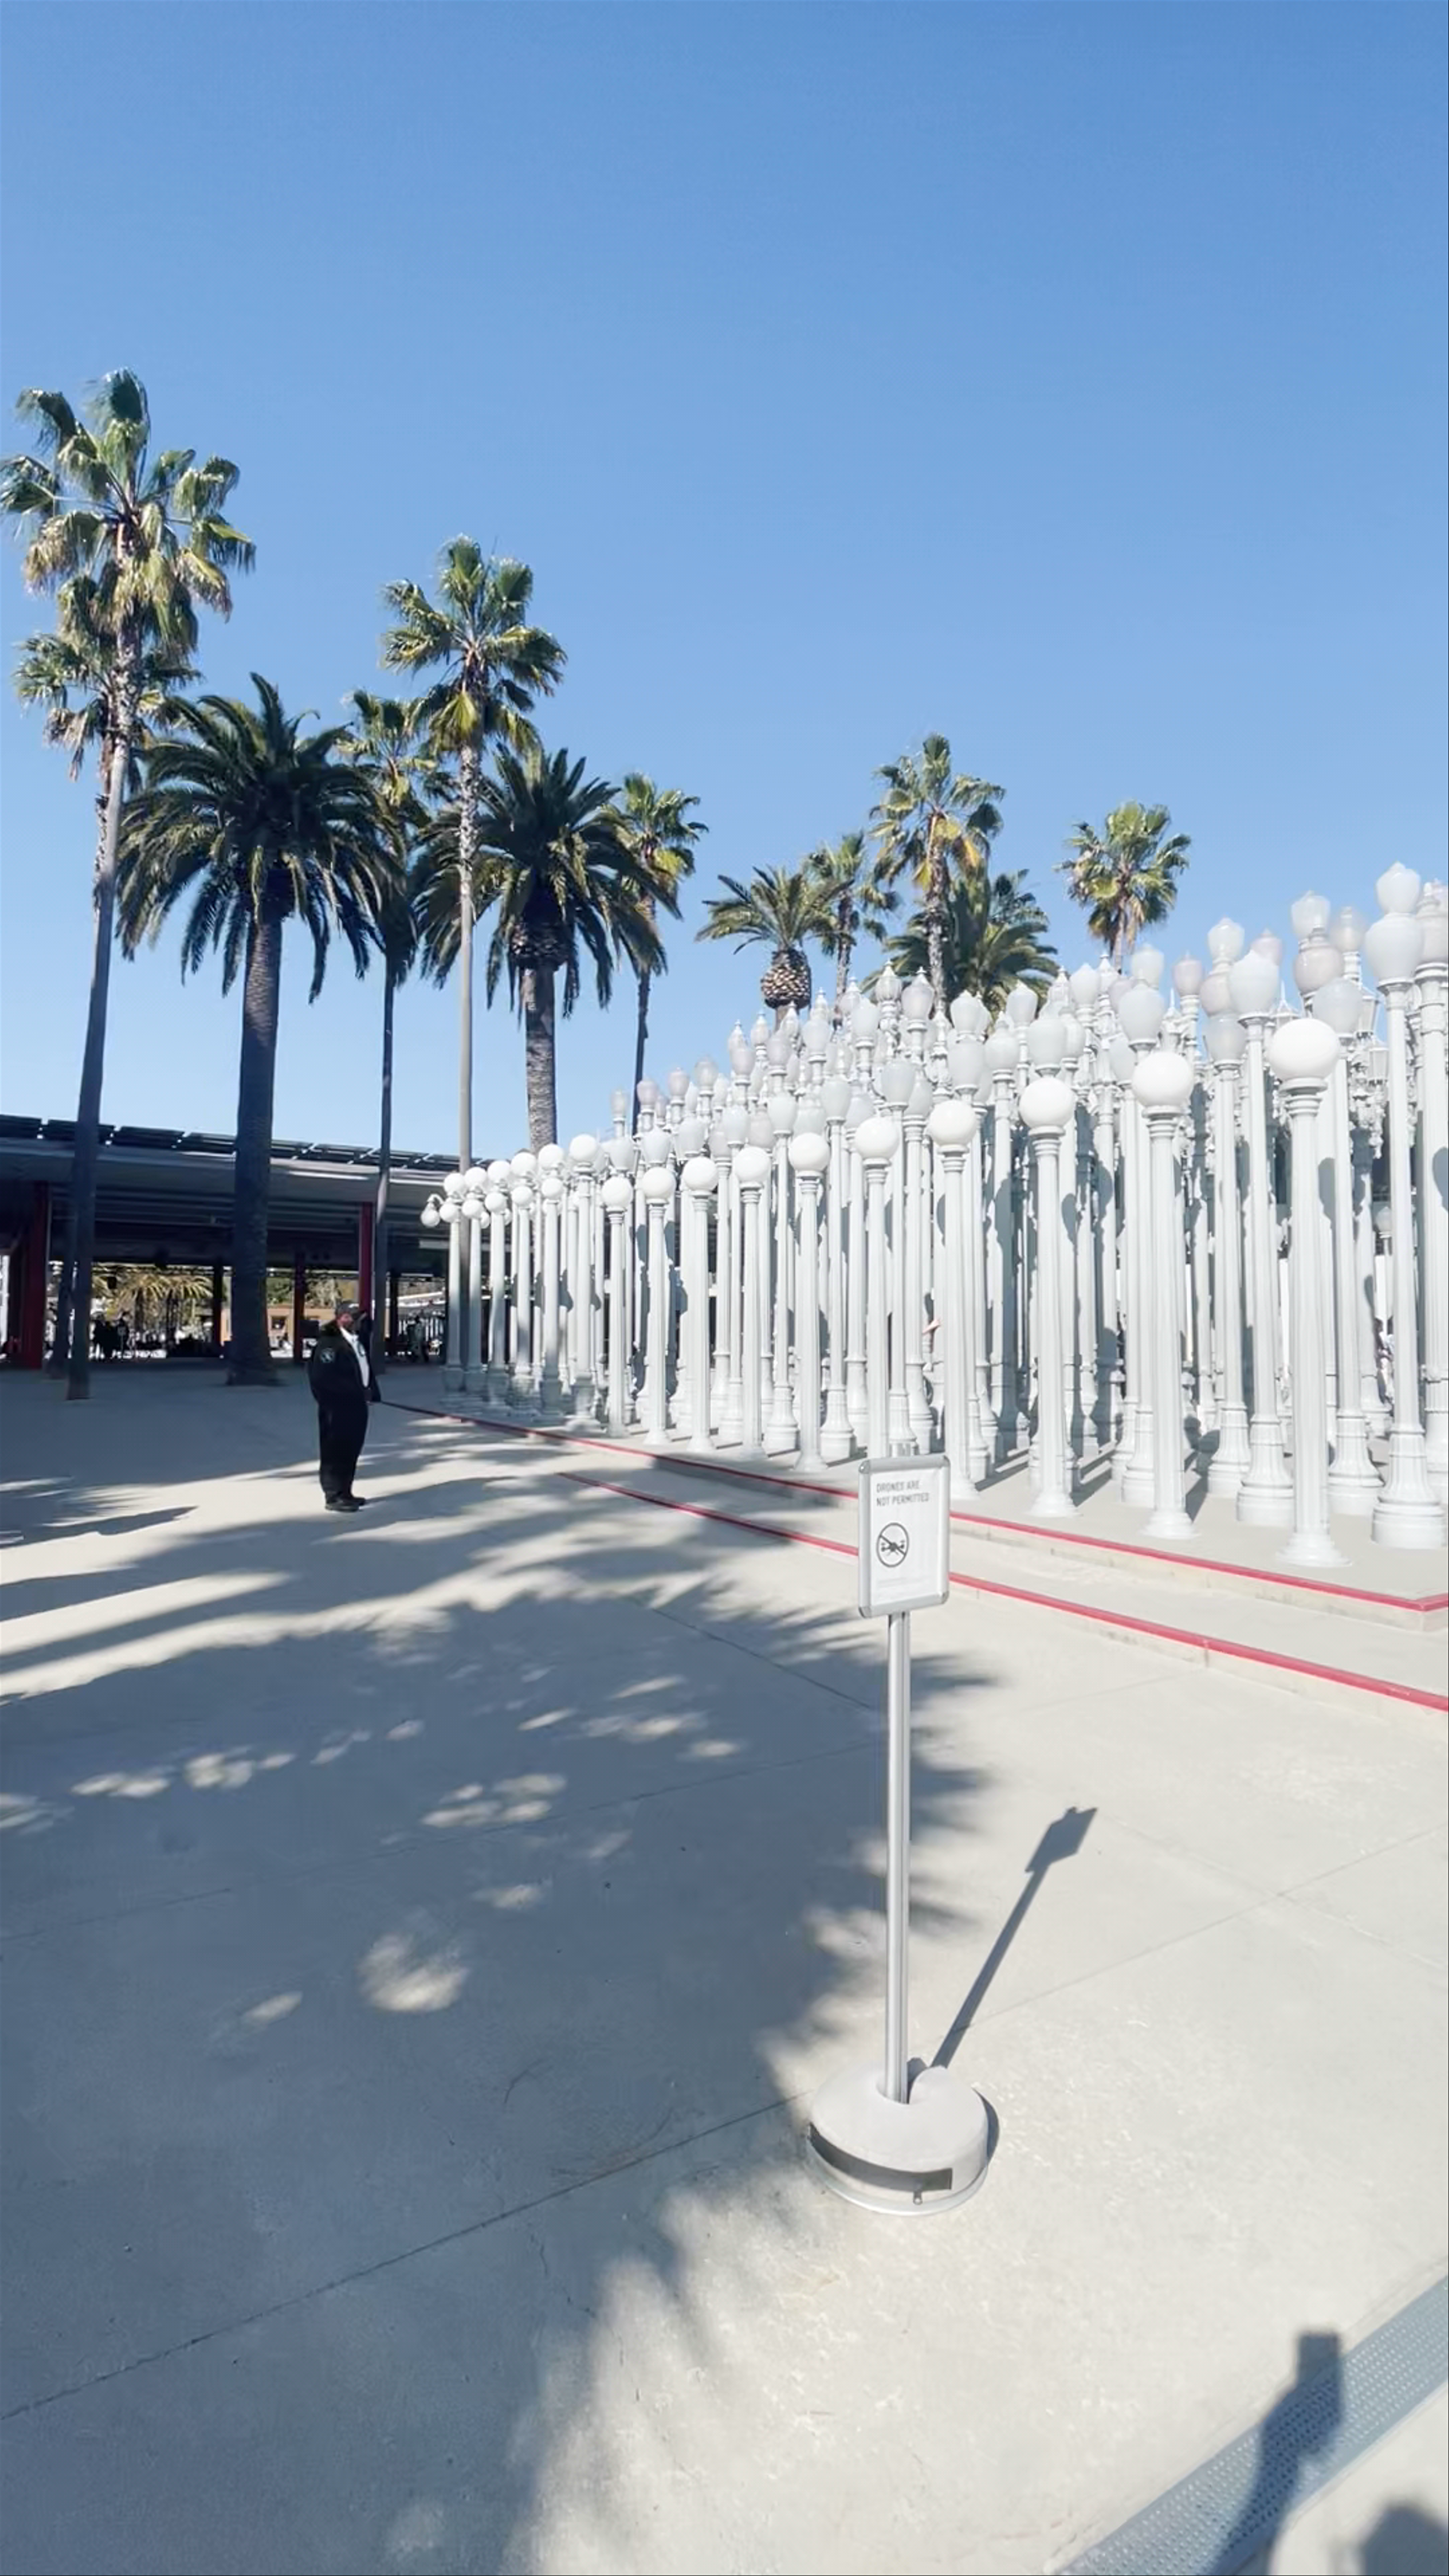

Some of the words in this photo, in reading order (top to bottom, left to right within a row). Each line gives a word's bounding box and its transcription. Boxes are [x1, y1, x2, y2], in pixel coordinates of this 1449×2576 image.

[877, 1481, 904, 1493] DRONES
[907, 1480, 920, 1489] ARE
[877, 1496, 889, 1507] NOT
[892, 1492, 929, 1505] PERMITTED
